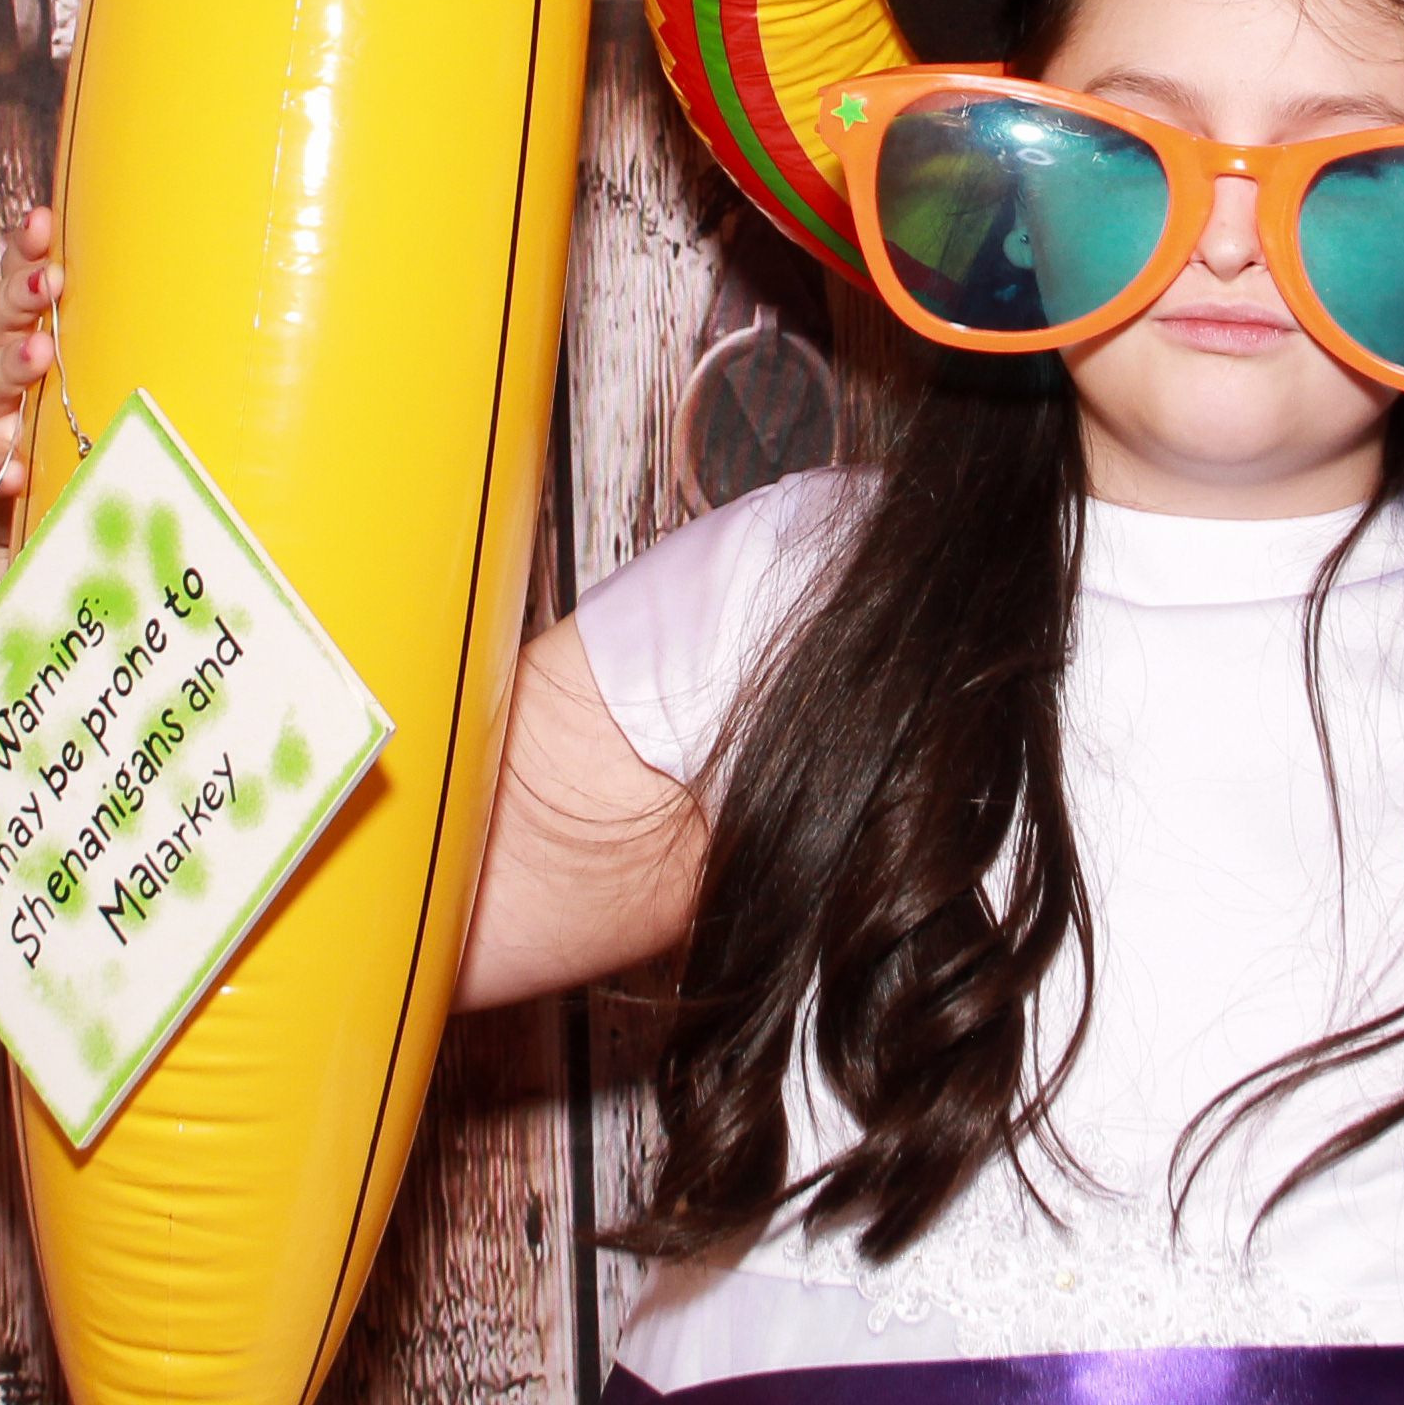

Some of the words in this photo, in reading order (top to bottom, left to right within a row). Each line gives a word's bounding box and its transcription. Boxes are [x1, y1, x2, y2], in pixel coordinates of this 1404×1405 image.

[11, 708, 185, 969] Shenanigans
[181, 616, 243, 712] and
[38, 740, 84, 801] be
[81, 618, 167, 757] prone
[164, 567, 204, 619] to
[98, 753, 236, 946] Malarkey
